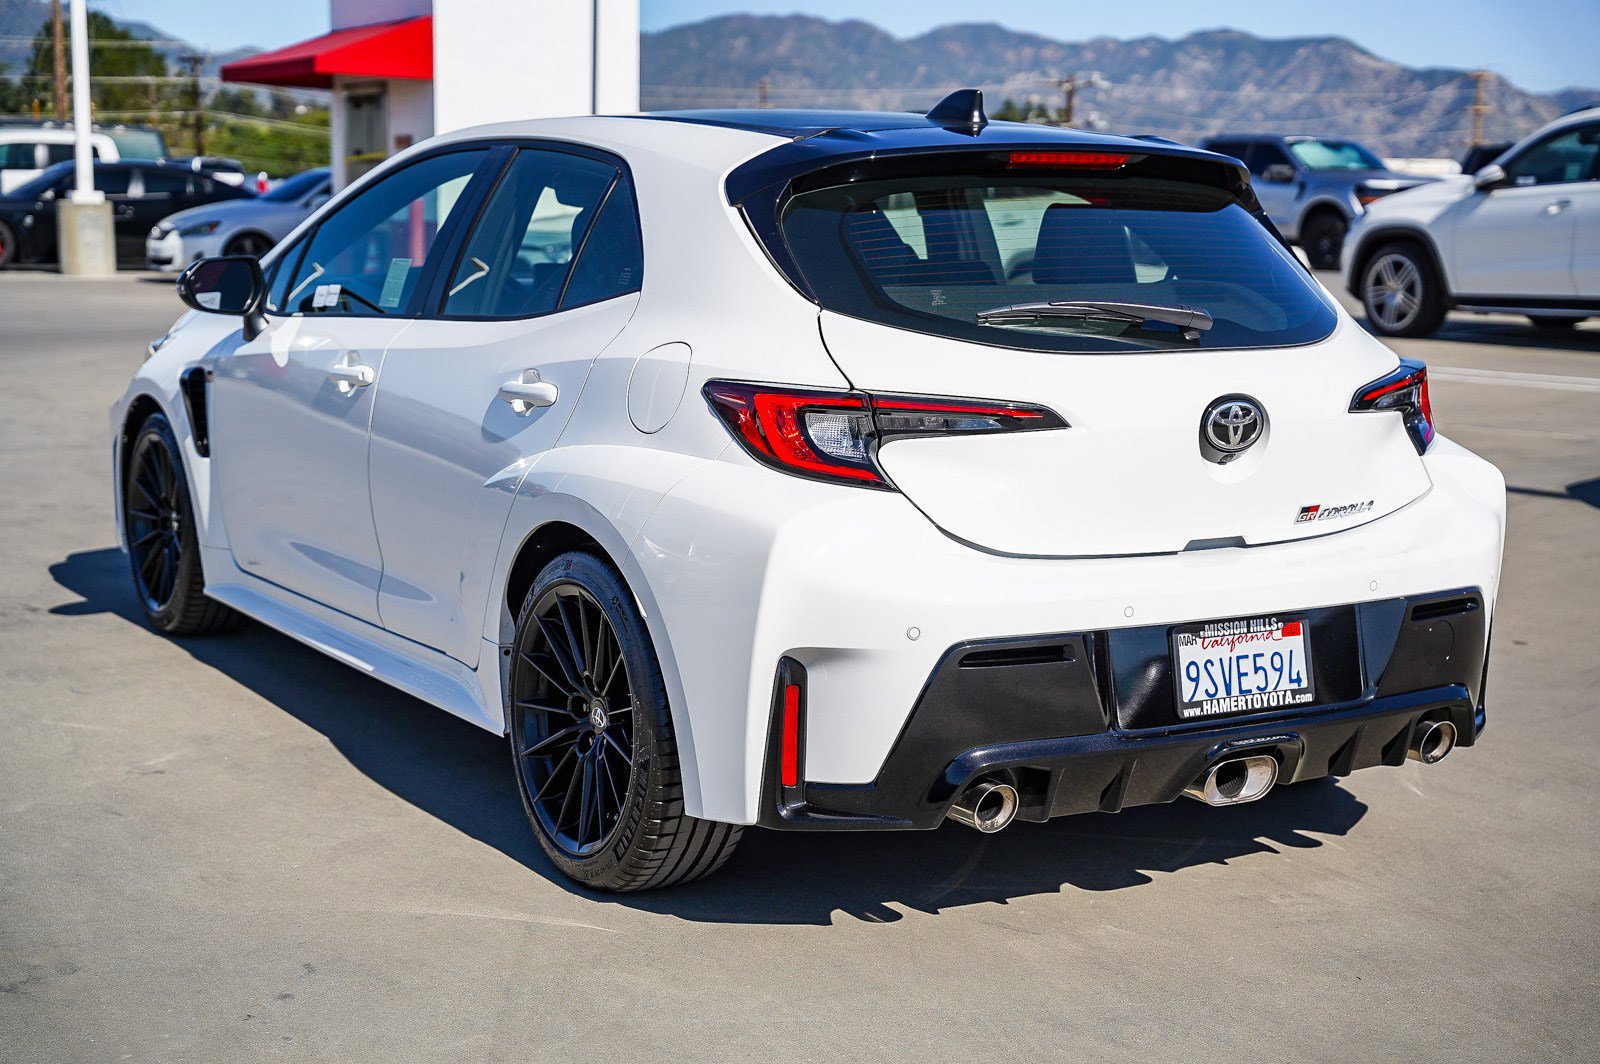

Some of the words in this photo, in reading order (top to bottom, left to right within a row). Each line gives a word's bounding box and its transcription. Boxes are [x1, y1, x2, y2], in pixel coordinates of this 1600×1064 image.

[1204, 620, 1248, 638] MISSION
[1250, 617, 1278, 633] HILLS
[1201, 630, 1283, 653] California
[1185, 649, 1302, 702] 9SVE594
[1183, 690, 1312, 718] www.HAMERTOYOTA.com
